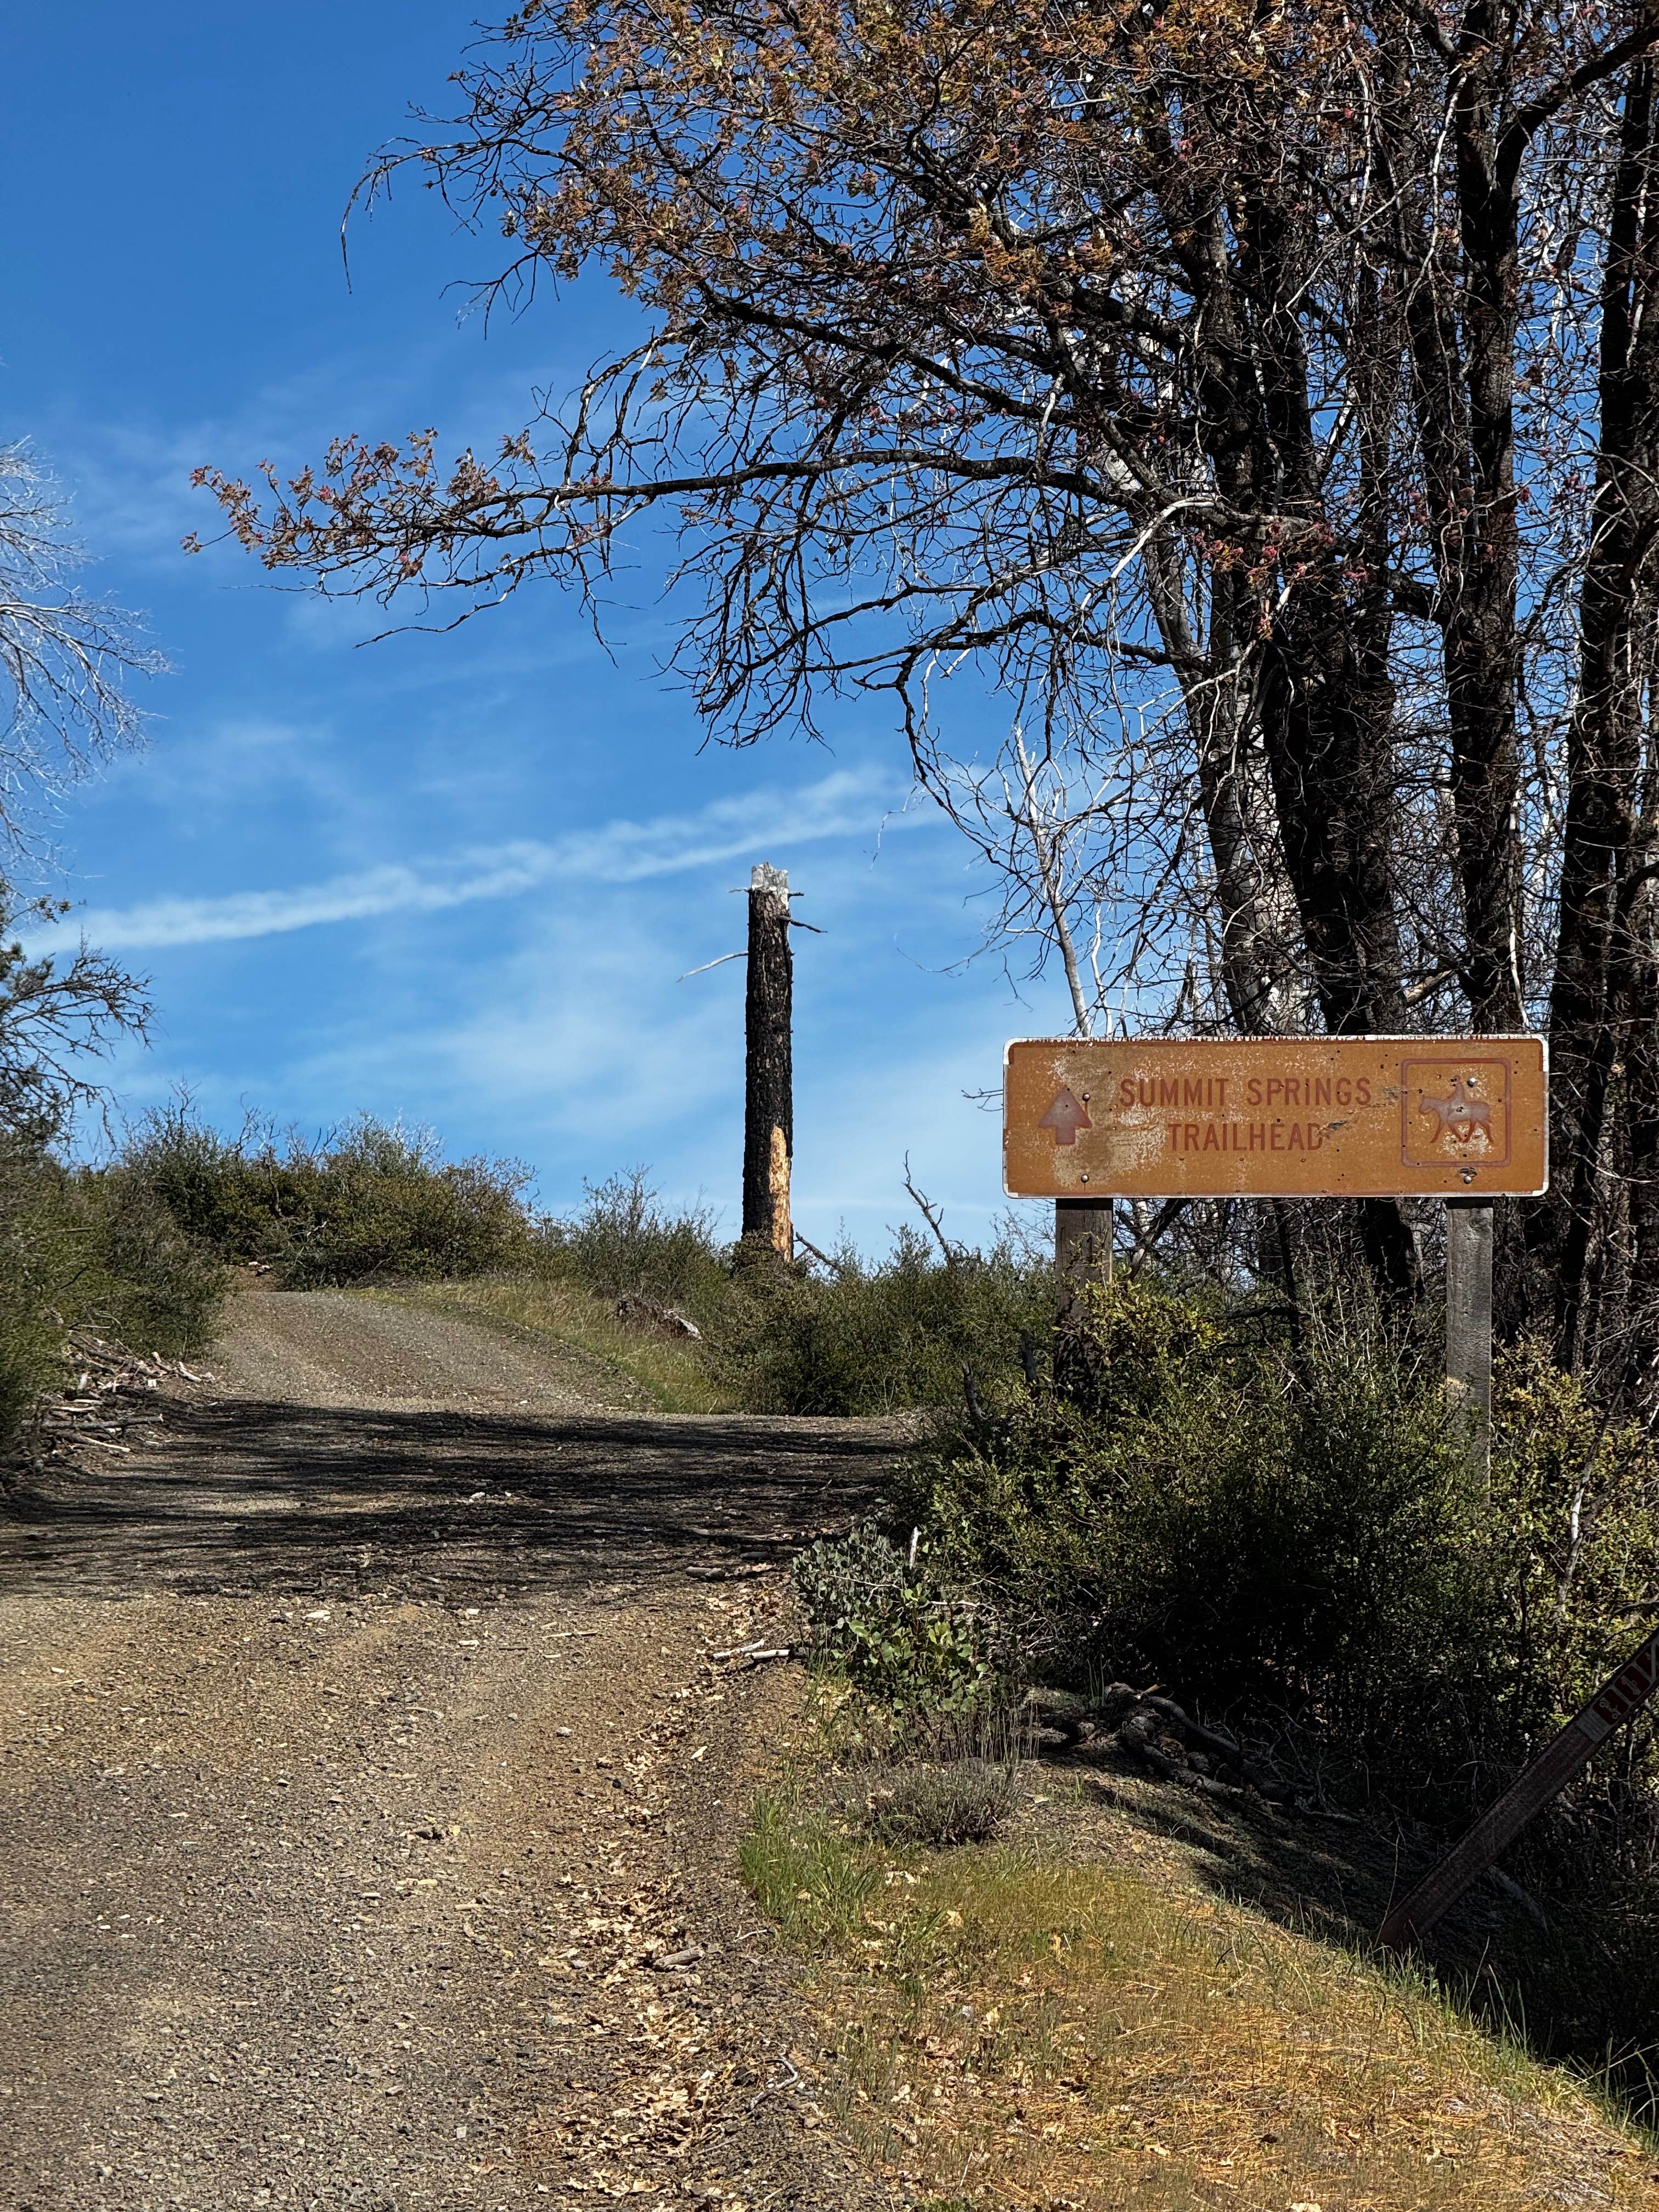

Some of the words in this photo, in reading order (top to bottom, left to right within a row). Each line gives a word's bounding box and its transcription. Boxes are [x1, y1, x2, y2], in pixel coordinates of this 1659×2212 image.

[1120, 1078, 1229, 1107] SUMMIT
[1247, 1077, 1372, 1106] SPRINGS
[1167, 1123, 1323, 1151] TRAILHEAD
